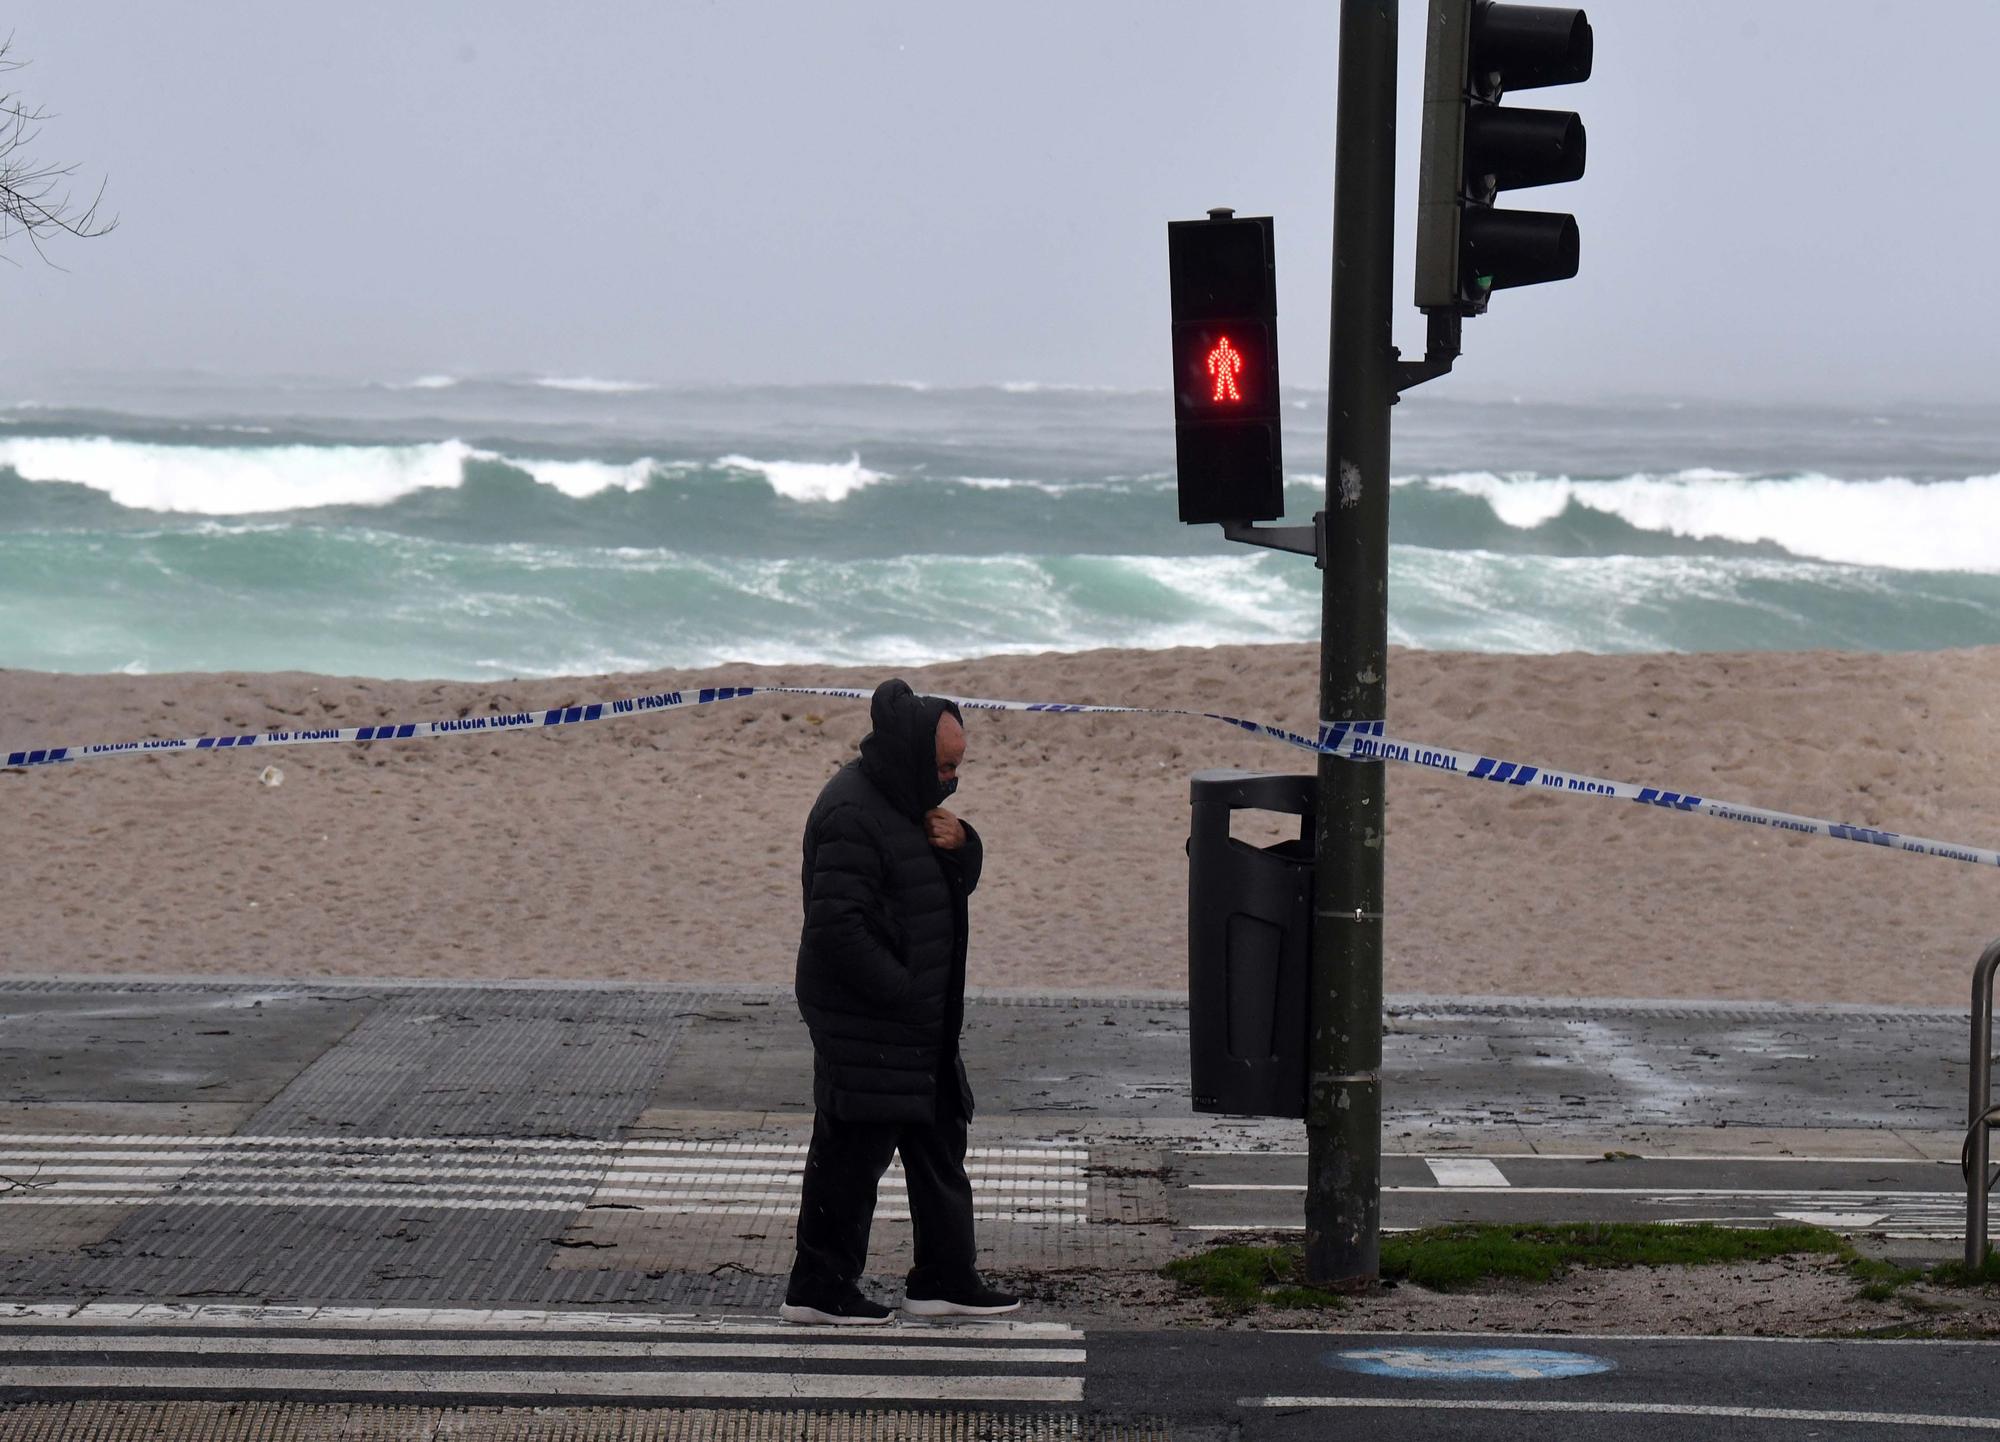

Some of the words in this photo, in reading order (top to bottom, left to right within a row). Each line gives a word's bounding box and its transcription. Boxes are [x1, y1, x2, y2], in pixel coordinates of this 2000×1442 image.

[612, 699, 633, 713] NO
[637, 691, 683, 710] PASAR
[1352, 737, 1410, 762] POLICIA
[1414, 749, 1458, 771] LOCAL
[1541, 773, 1564, 788] NO
[1567, 778, 1616, 797] PASAR
